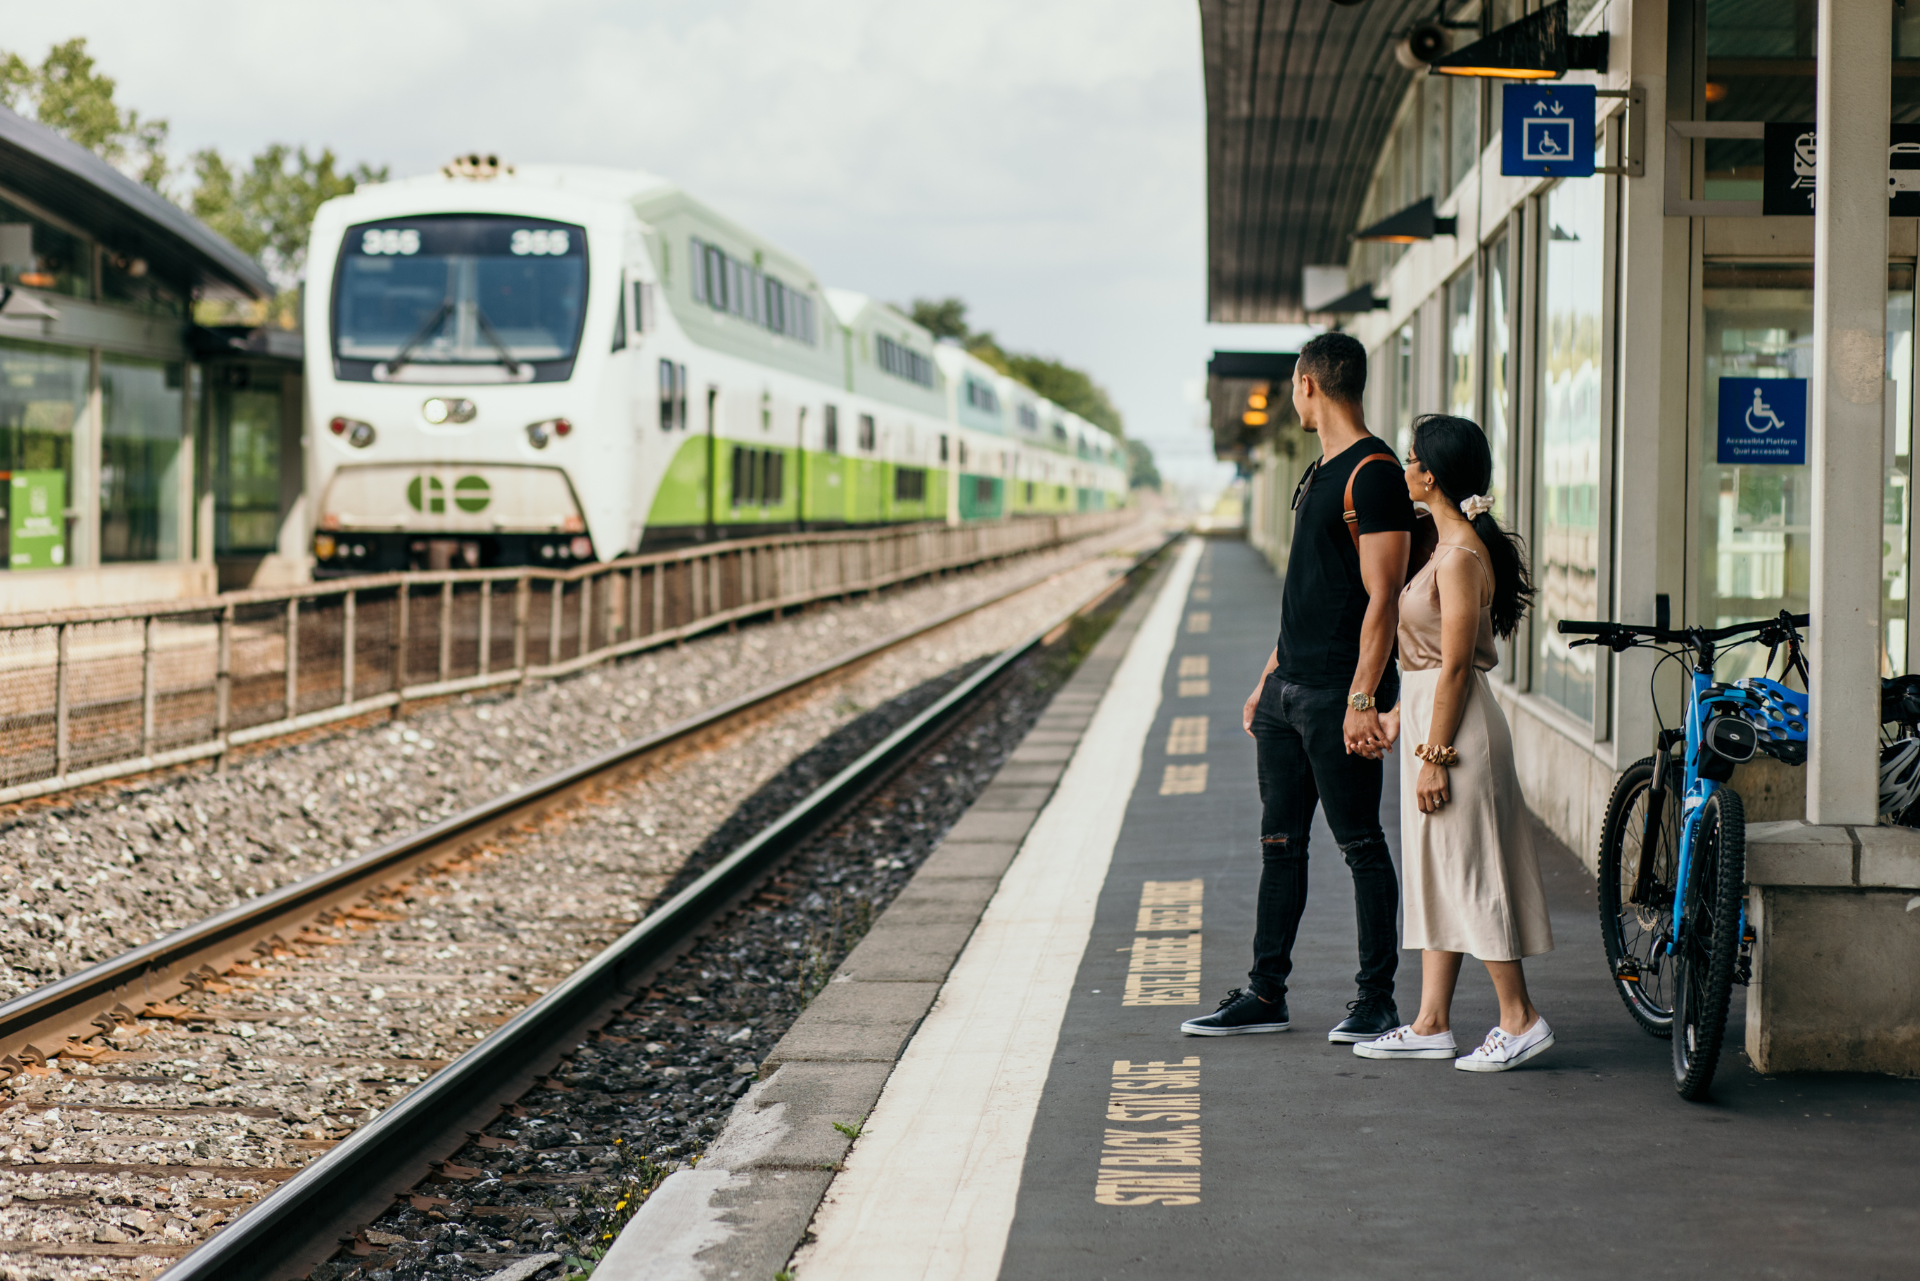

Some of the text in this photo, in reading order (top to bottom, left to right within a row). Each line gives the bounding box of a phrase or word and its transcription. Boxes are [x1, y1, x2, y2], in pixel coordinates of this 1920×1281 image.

[1807, 192, 1814, 209] 1
[1726, 437, 1798, 445] Accessible Platform
[1751, 447, 1790, 455] accessible
[407, 475, 491, 513] GO
[1121, 972, 1201, 1006] RESTEZ
[1095, 1056, 1202, 1206] STAY BACK. STAY SAFE.
